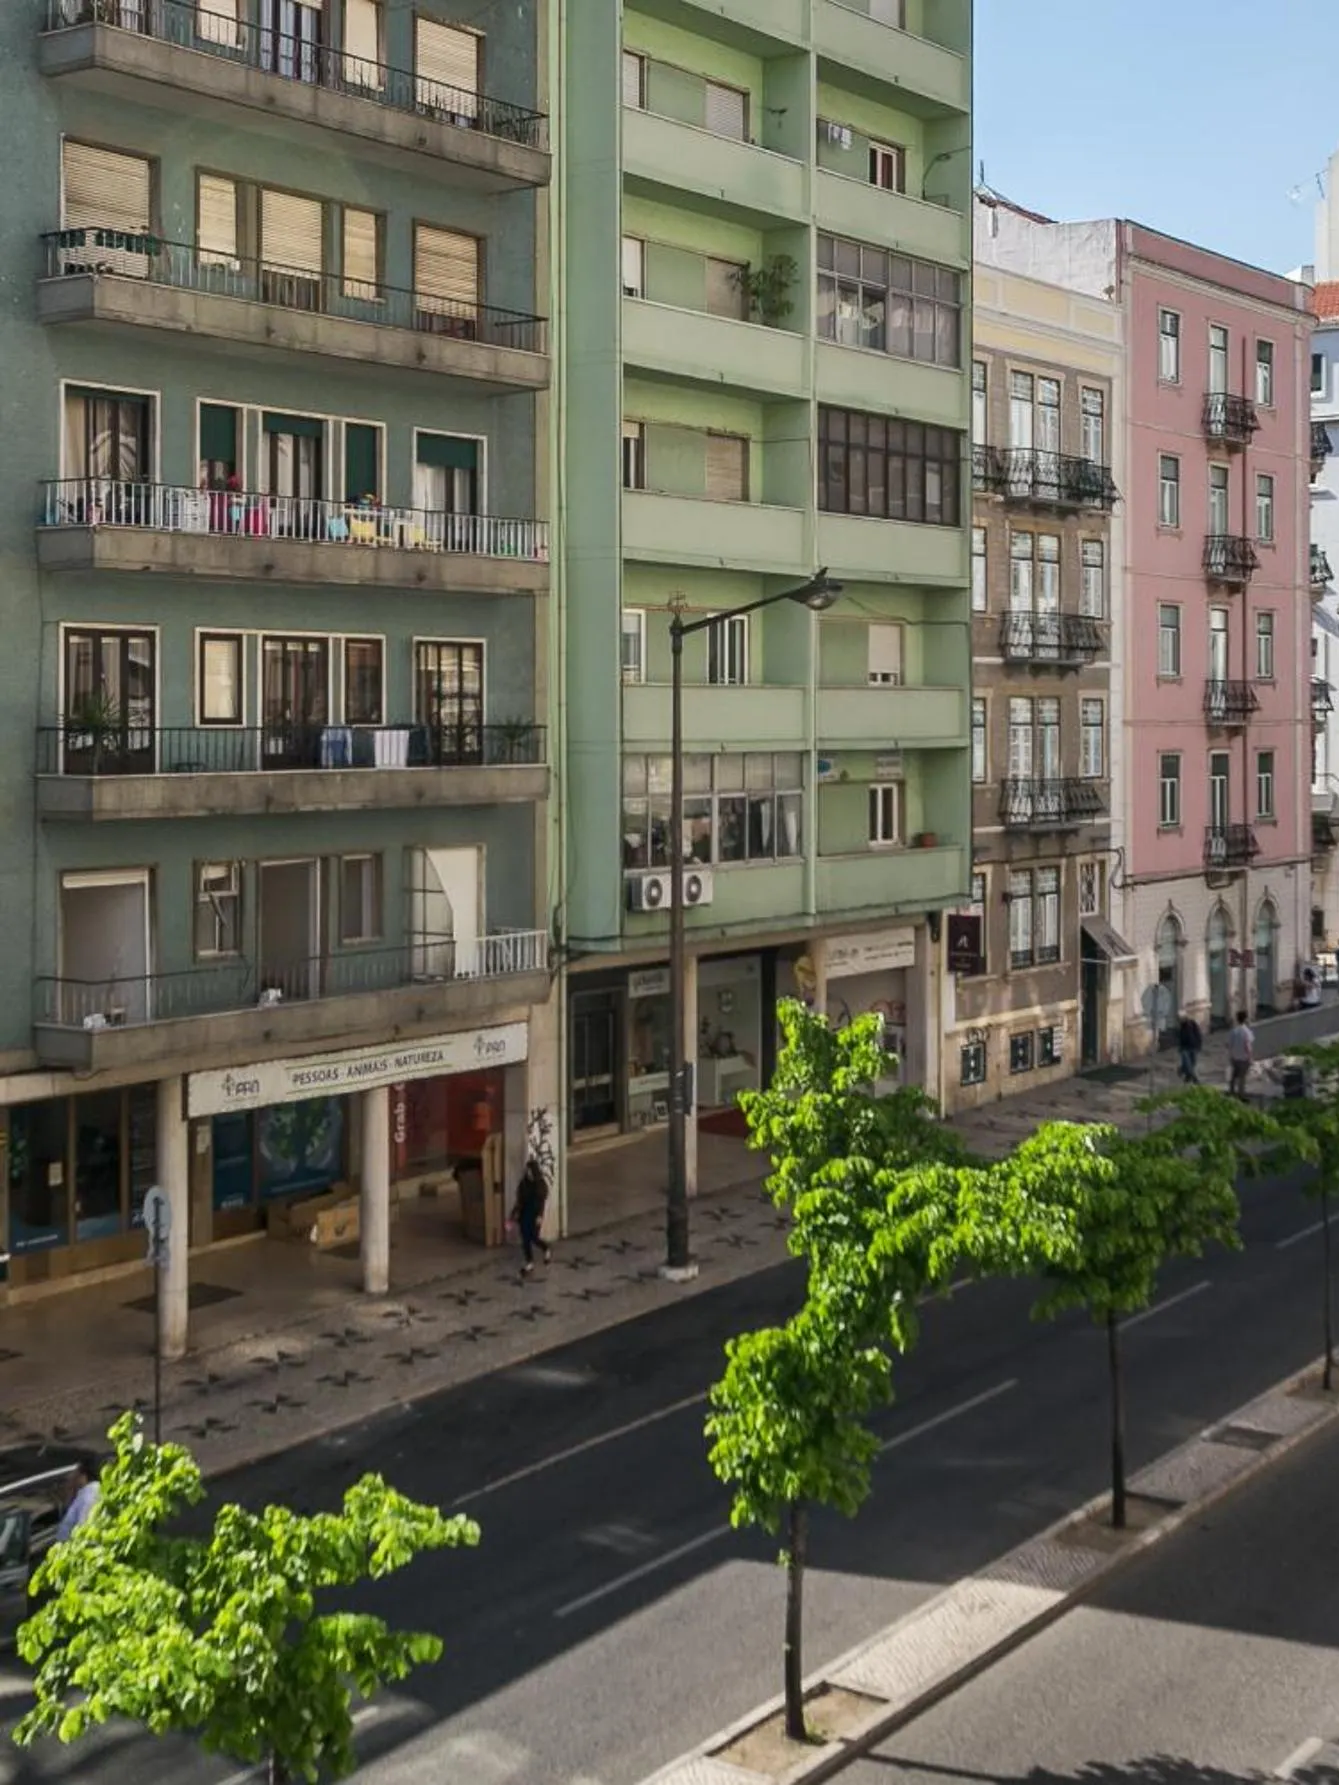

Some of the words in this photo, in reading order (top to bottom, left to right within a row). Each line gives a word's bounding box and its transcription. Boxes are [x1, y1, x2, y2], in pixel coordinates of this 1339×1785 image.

[292, 1066, 339, 1086] PESSOAS
[345, 1057, 389, 1079] ANIMAIS
[394, 1049, 445, 1068] NATUREZA
[393, 1101, 406, 1144] Grab
